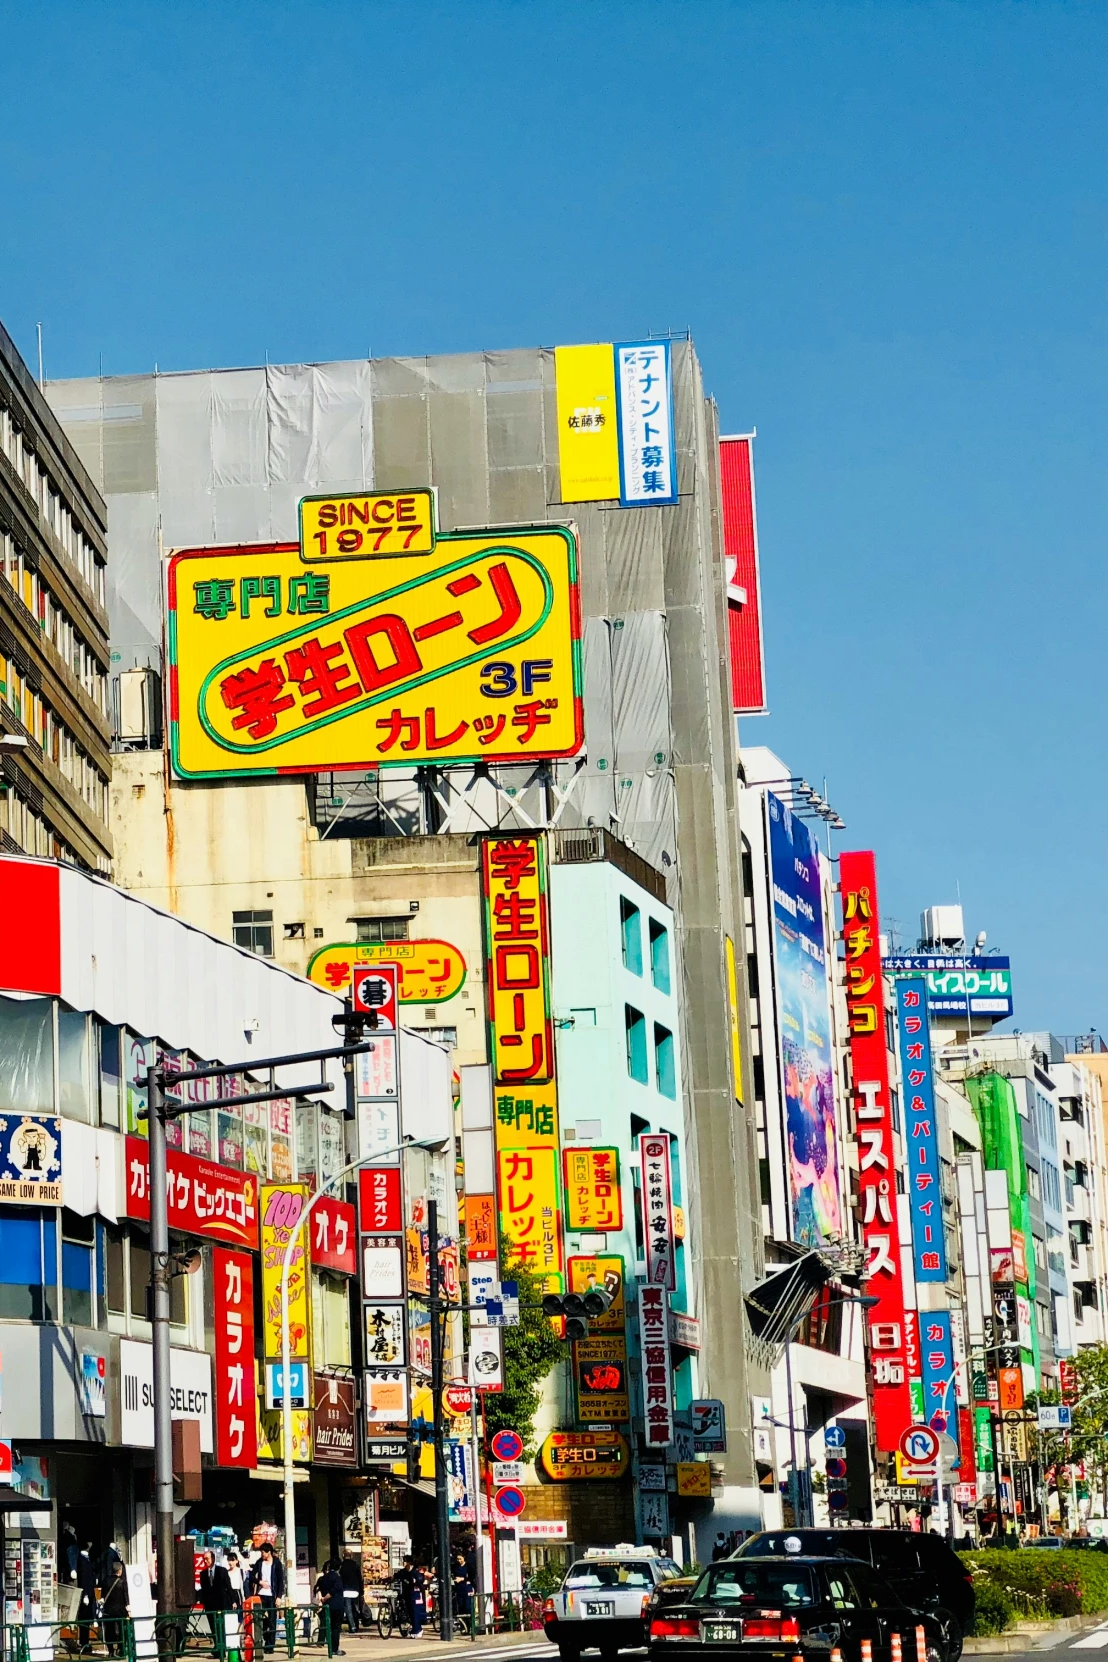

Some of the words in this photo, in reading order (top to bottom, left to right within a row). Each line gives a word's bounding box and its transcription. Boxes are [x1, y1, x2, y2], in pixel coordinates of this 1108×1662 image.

[568, 413, 606, 428] 佐藤秀
[638, 350, 665, 493] テナント募集
[318, 497, 417, 527] SINCE
[313, 524, 423, 556] 1977
[220, 561, 523, 742] 学生ローン
[480, 659, 554, 698] 3F
[490, 840, 543, 1080] 学生ローン
[845, 887, 878, 1033] パチンコ
[497, 1095, 554, 1135] 専門店
[648, 1146, 662, 1154] 2F
[575, 1156, 587, 1181] 専門店
[857, 1081, 896, 1276] エスパス
[20, 1183, 36, 1198] LOW
[40, 1183, 60, 1200] PRICE
[194, 1178, 254, 1228] ビッグエコー
[373, 1173, 388, 1228] カラオケ
[593, 1152, 613, 1225] 学生ローン
[264, 1190, 303, 1229] 100
[366, 1238, 397, 1248] 美容室
[542, 1206, 554, 1267] 当ビル3F
[472, 1277, 493, 1286] Step
[494, 1294, 510, 1302] 先発
[609, 1308, 624, 1318] 3F
[488, 1315, 519, 1326] 時差式
[225, 1260, 245, 1458] カラオケ
[871, 1323, 904, 1385] 日拓
[169, 1386, 208, 1415] SELECT
[316, 1425, 332, 1445] hair
[371, 1445, 406, 1456] 菊月ビル
[552, 1434, 619, 1445] 学生ローン
[713, 1630, 737, 1640] 68-08
